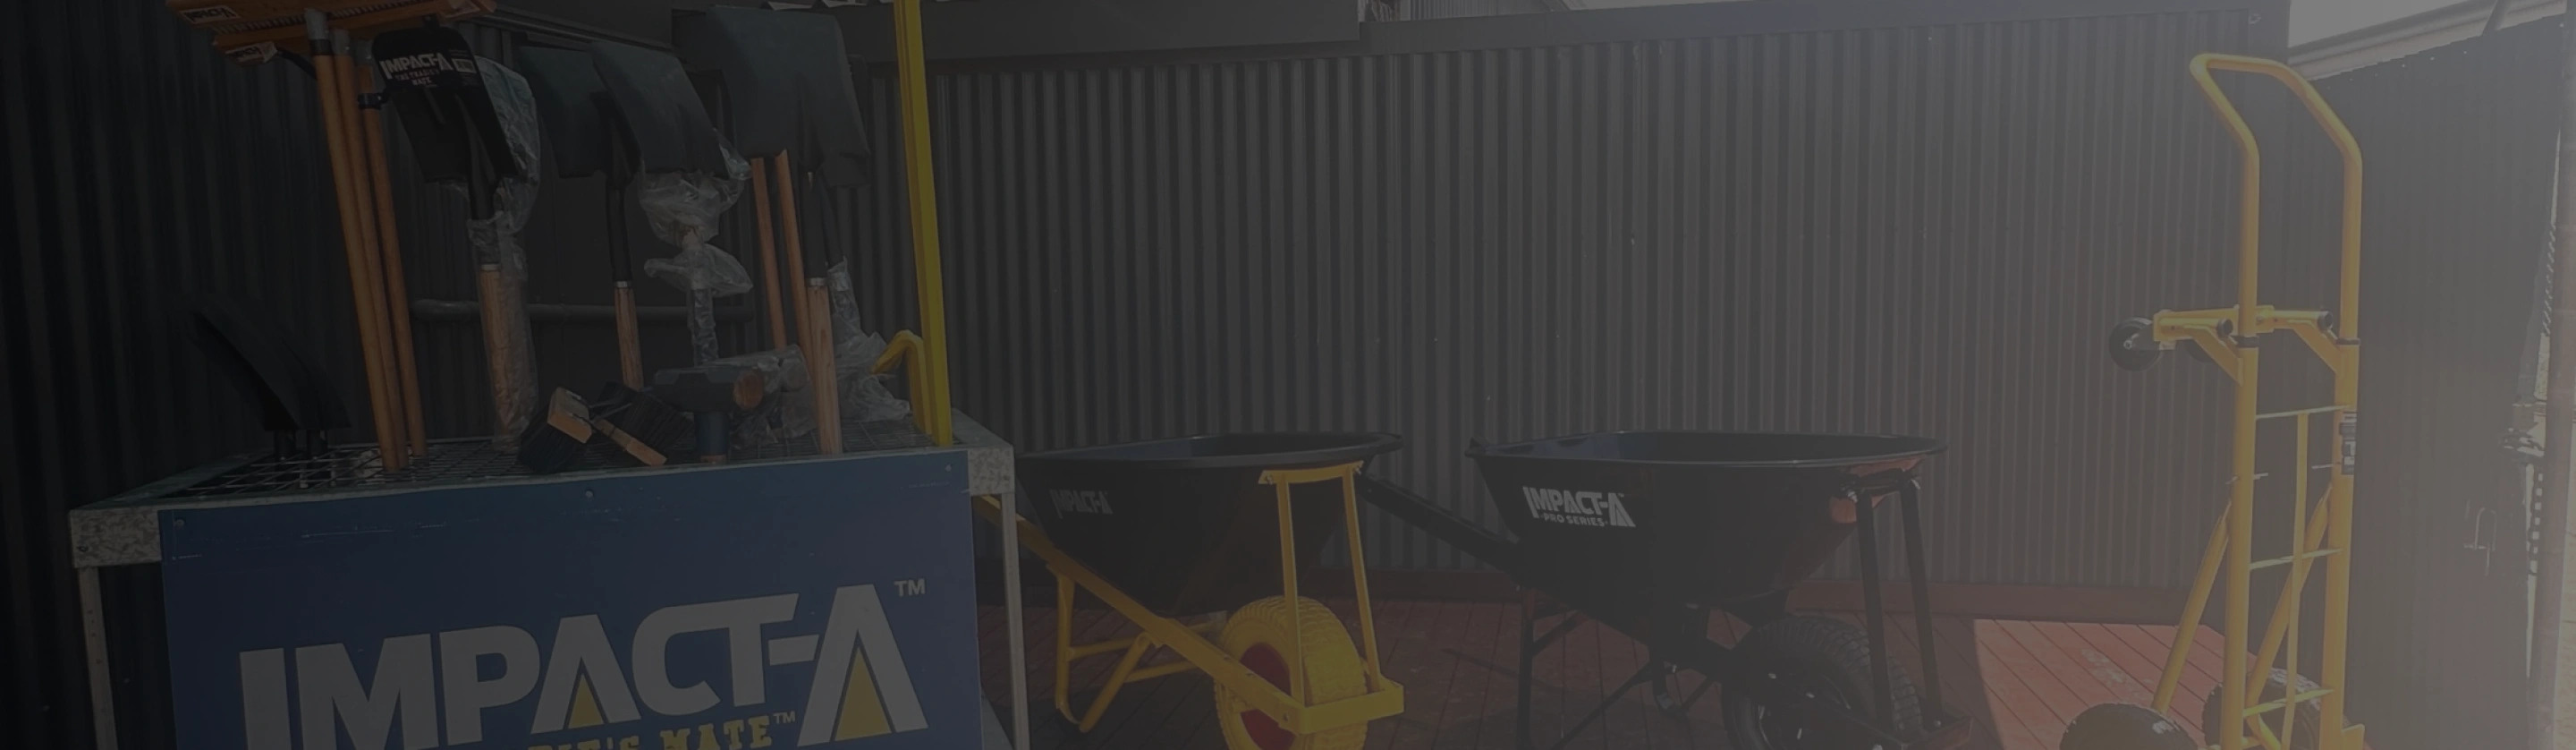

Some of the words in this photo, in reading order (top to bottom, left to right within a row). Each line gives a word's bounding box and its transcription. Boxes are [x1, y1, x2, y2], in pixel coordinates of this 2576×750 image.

[379, 53, 453, 80] IMPACT-A
[1048, 489, 1113, 519] IMPACT-A
[1522, 486, 1636, 527] IMPACT-A
[1543, 513, 1564, 523] PRO
[1565, 516, 1605, 526] SERIES
[240, 583, 928, 750] IMPACT-A
